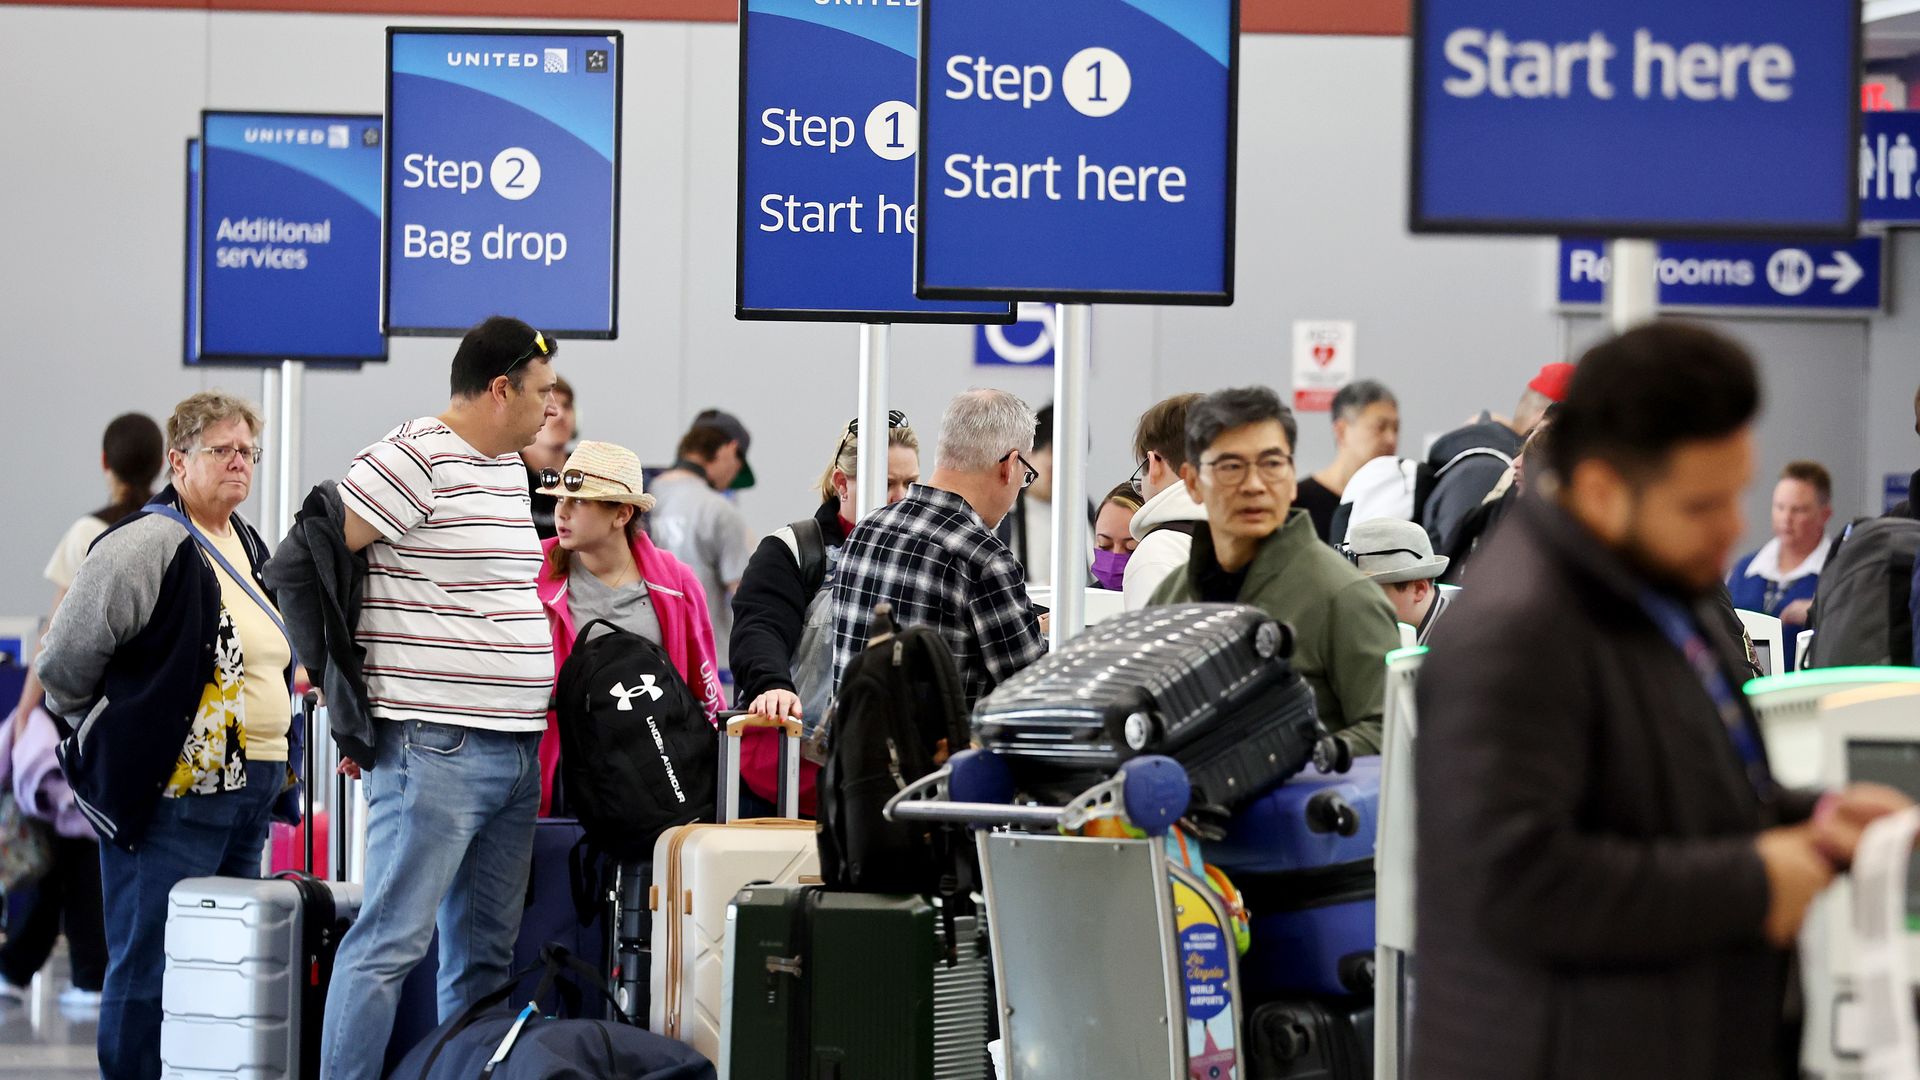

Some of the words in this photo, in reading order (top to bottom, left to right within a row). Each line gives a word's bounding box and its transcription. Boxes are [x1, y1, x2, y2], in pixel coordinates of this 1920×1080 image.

[447, 52, 539, 67] UNITED
[1444, 28, 1614, 99] Start
[1633, 29, 1794, 101] here
[945, 54, 1053, 109] Step
[1086, 61, 1108, 102] 1
[244, 128, 325, 145] UNITED
[761, 107, 855, 153] Step
[885, 111, 905, 147] 1
[403, 153, 483, 195] Step
[505, 157, 525, 189] 2
[944, 153, 1062, 201] Start
[1077, 153, 1187, 203] here
[216, 217, 331, 245] Additional
[759, 193, 863, 234] Start
[878, 194, 918, 234] he
[216, 246, 308, 270] services
[404, 224, 472, 265] Bag
[481, 223, 568, 266] drop
[1569, 249, 1755, 287] Rerooms
[645, 715, 665, 754] UNDER
[660, 754, 686, 803] ARMOUR
[1189, 984, 1215, 995] WORLD
[1189, 995, 1225, 1006] AIRPORTS
